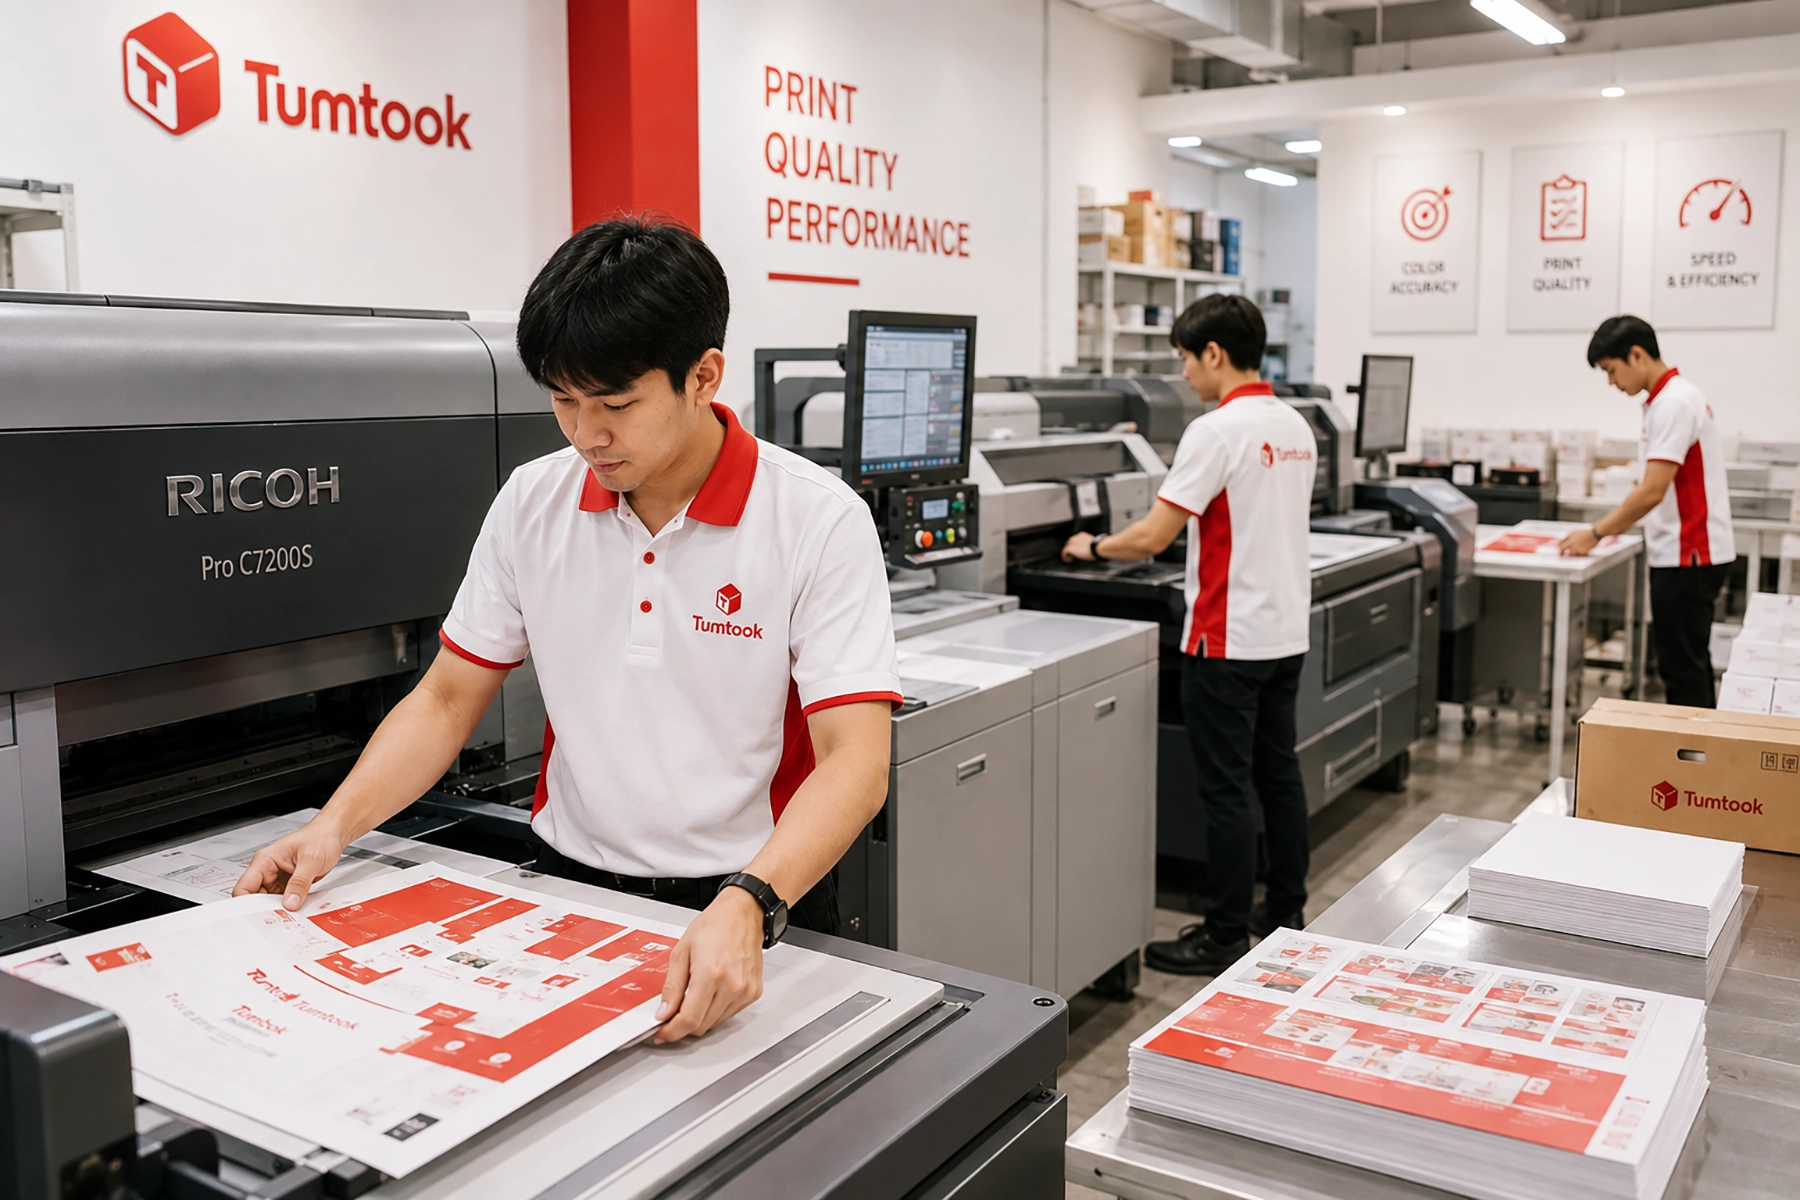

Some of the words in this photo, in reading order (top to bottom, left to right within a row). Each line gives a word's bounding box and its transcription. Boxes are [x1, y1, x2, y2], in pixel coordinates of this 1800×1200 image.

[244, 59, 472, 151] Tumtook
[765, 65, 857, 124] PRINT
[765, 131, 898, 190] QUALITY
[767, 197, 970, 257] PERFORMANCE
[1401, 260, 1446, 276] COLOR
[1543, 256, 1582, 271] PRINT
[1690, 251, 1738, 267] SPEED
[1388, 279, 1459, 295] ACCURACY
[1532, 275, 1593, 292] QUALITY
[1680, 271, 1760, 288] EFFICIENCY
[165, 466, 340, 517] RICOH
[201, 555, 235, 581] Pro
[239, 543, 314, 576] C7200S
[692, 615, 763, 639] Tumtook
[1684, 790, 1763, 815] Tumtook
